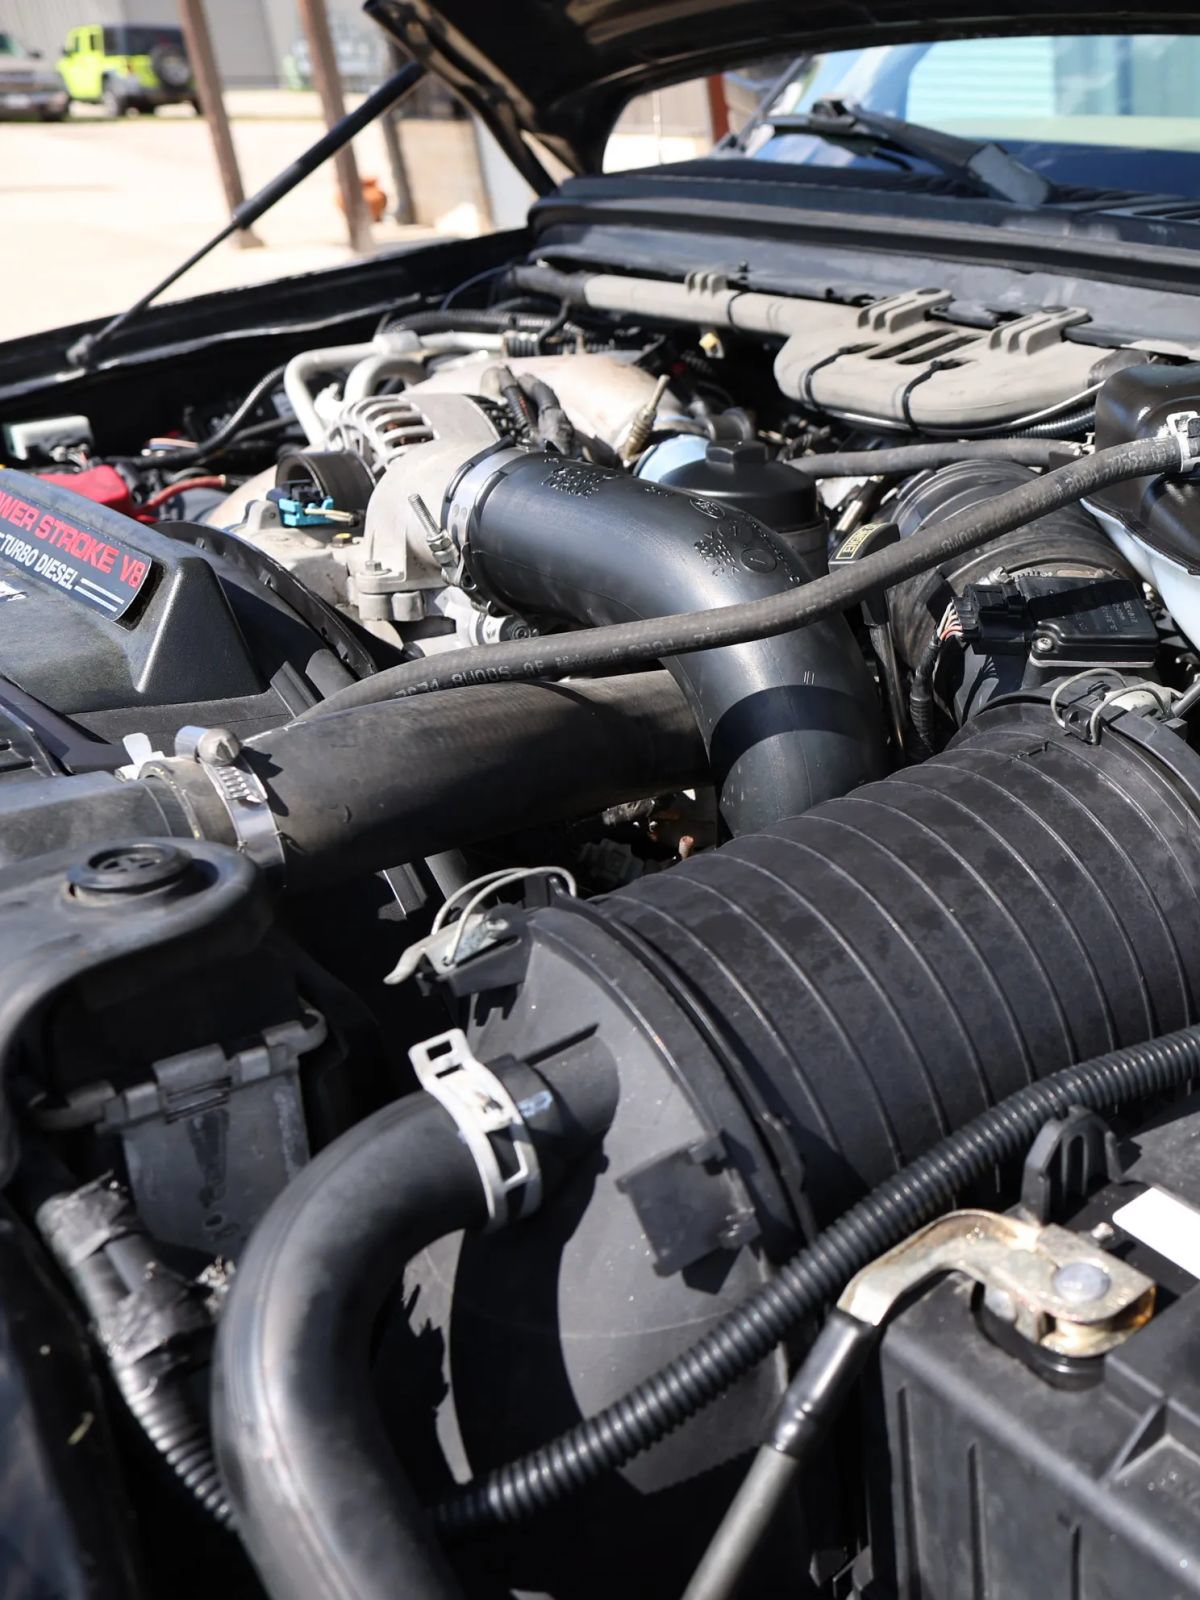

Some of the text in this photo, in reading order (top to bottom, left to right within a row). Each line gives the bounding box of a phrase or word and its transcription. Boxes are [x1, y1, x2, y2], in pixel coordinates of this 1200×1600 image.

[0, 533, 39, 567] TURBO
[34, 553, 79, 591] DIESEL
[35, 514, 119, 574] STROKE
[120, 555, 146, 589] V8
